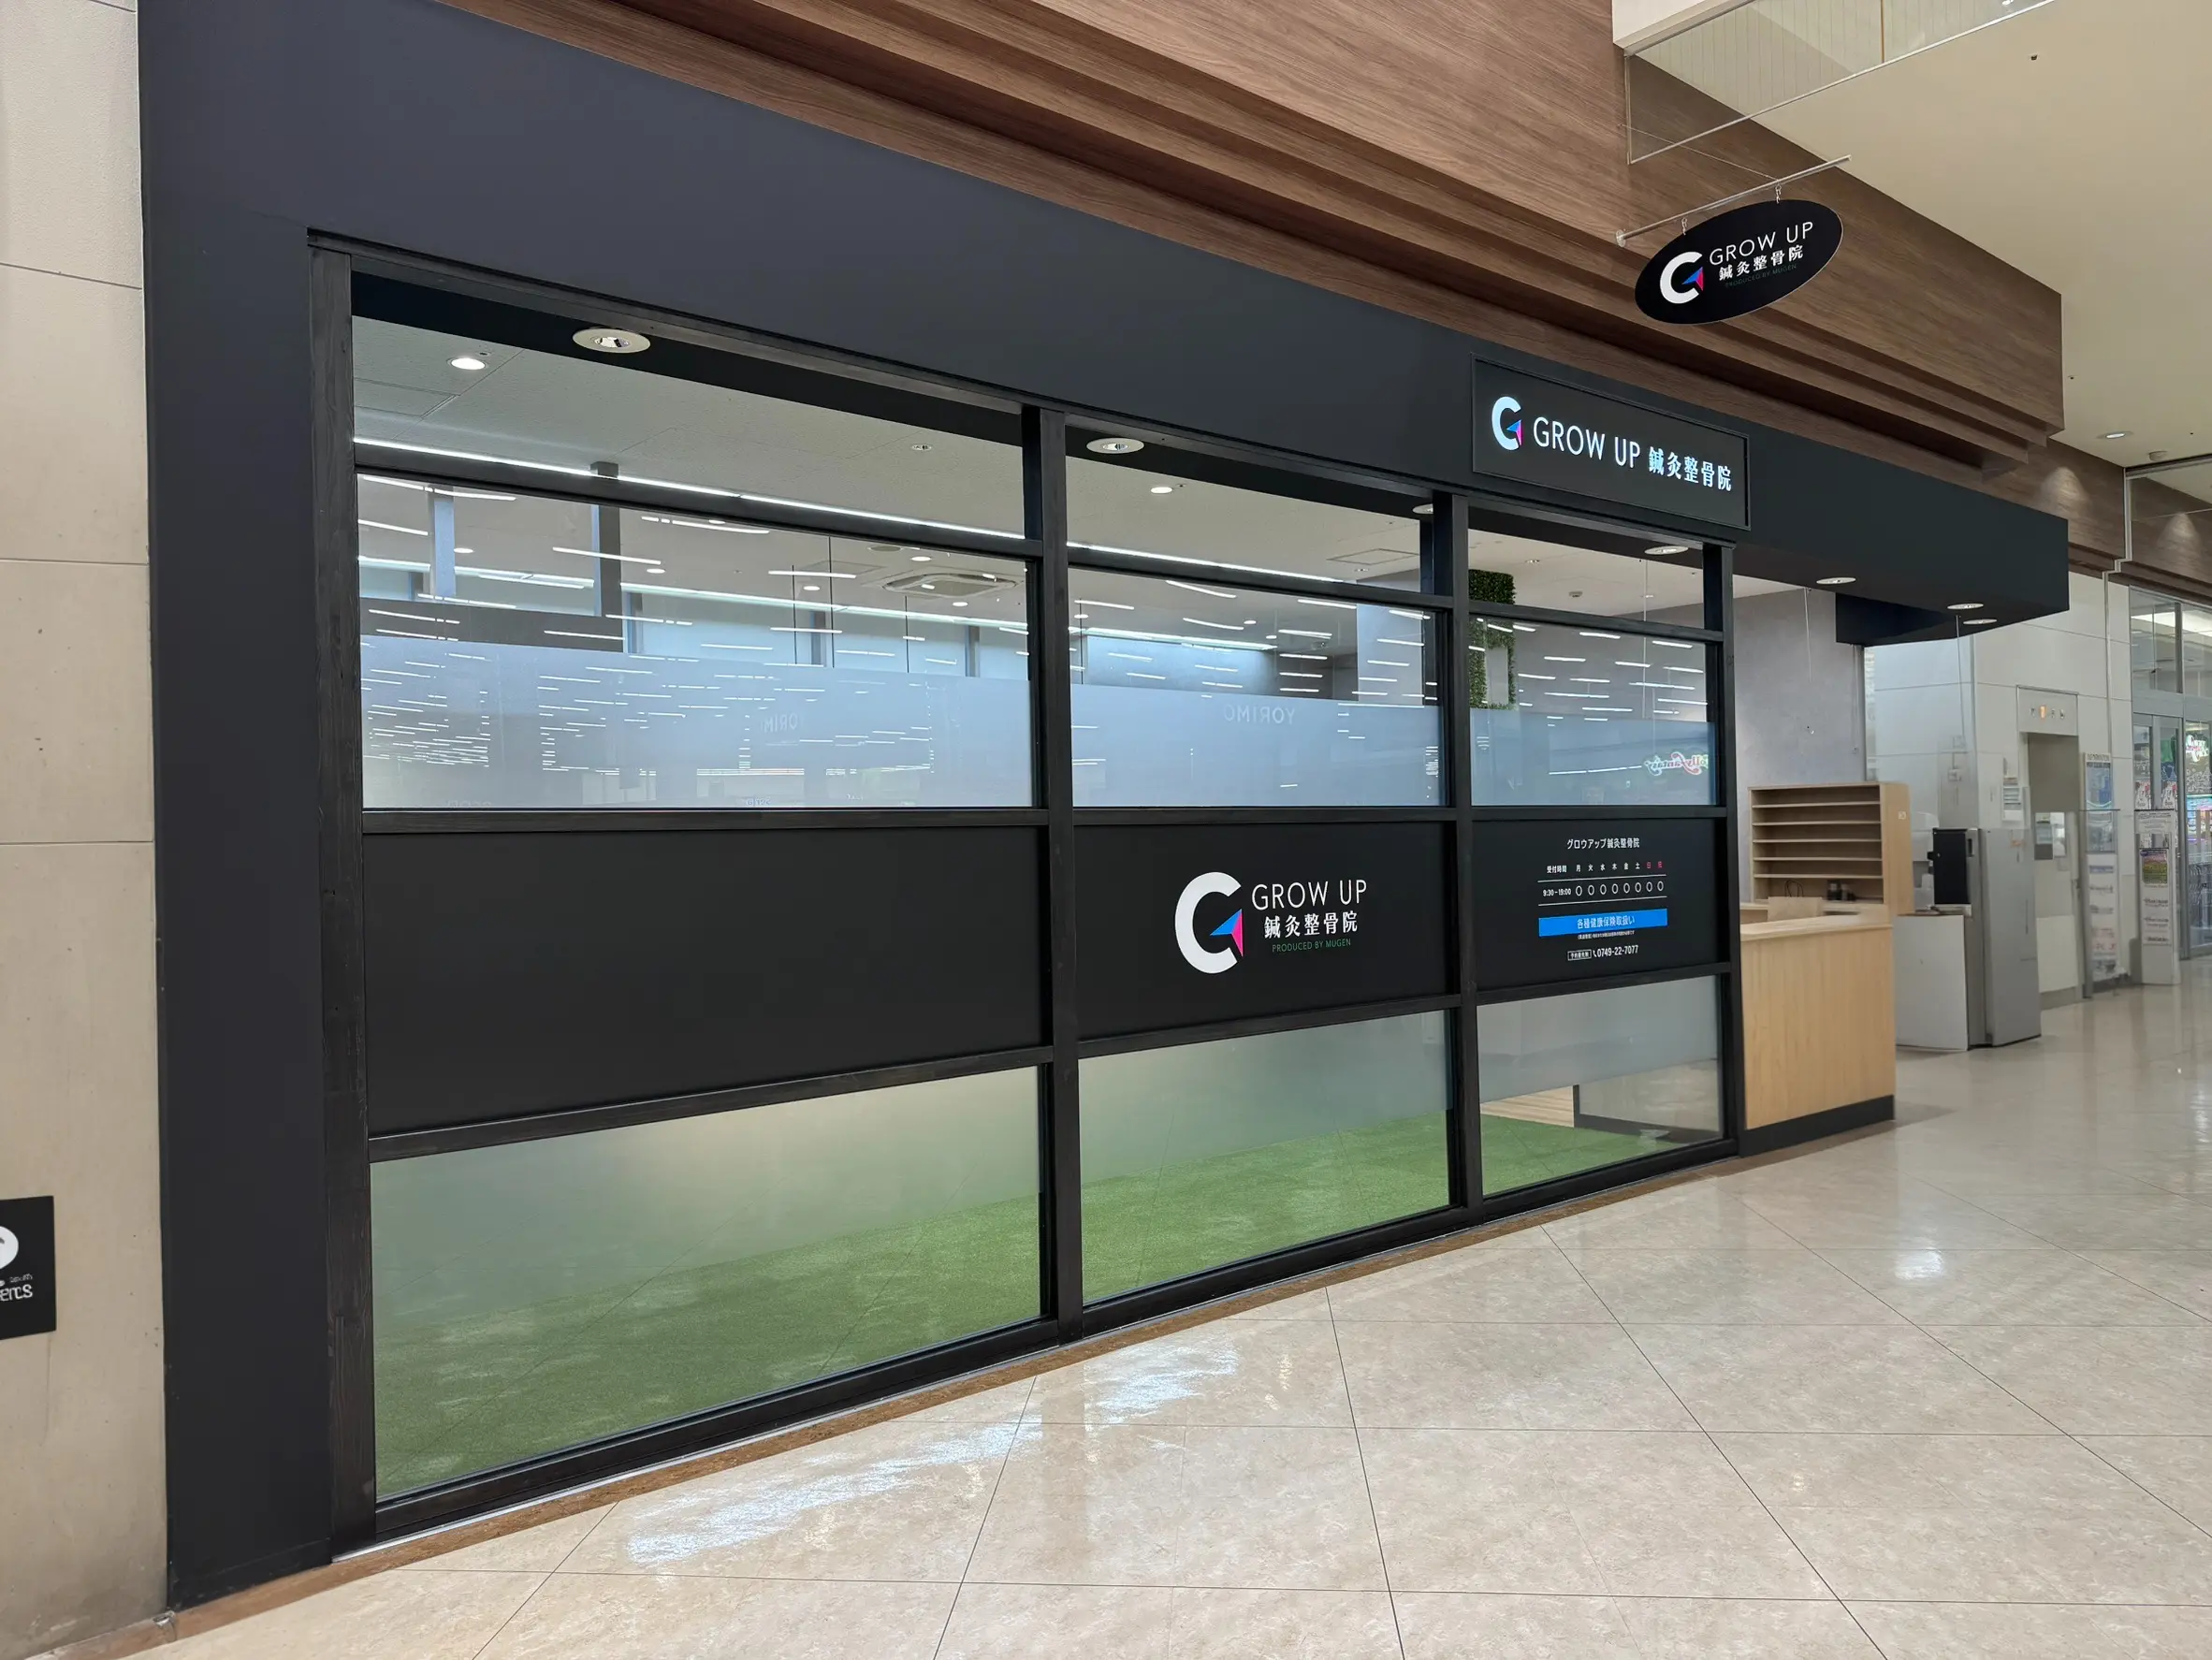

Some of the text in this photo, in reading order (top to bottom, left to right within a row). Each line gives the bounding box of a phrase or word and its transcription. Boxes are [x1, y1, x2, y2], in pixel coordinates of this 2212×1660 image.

[1709, 221, 1813, 266] GROW UP
[1718, 244, 1804, 282] 鍼灸整骨院
[1533, 416, 1732, 491] GROW UP 鍼灸整骨院
[1566, 837, 1640, 850] グロウアップ鍼灸整骨院
[1546, 865, 1567, 874] 受付時間
[1576, 864, 1581, 872] 月
[1611, 862, 1618, 870] 木
[1623, 862, 1629, 870] 金
[1251, 879, 1367, 911] GROW UP
[1263, 910, 1358, 939] 鍼灸整骨院
[1577, 915, 1636, 929] 各種健康保険取扱い
[1272, 938, 1351, 953] PRODUCED BY MUGEN
[1596, 944, 1639, 958] 0749-22-7077
